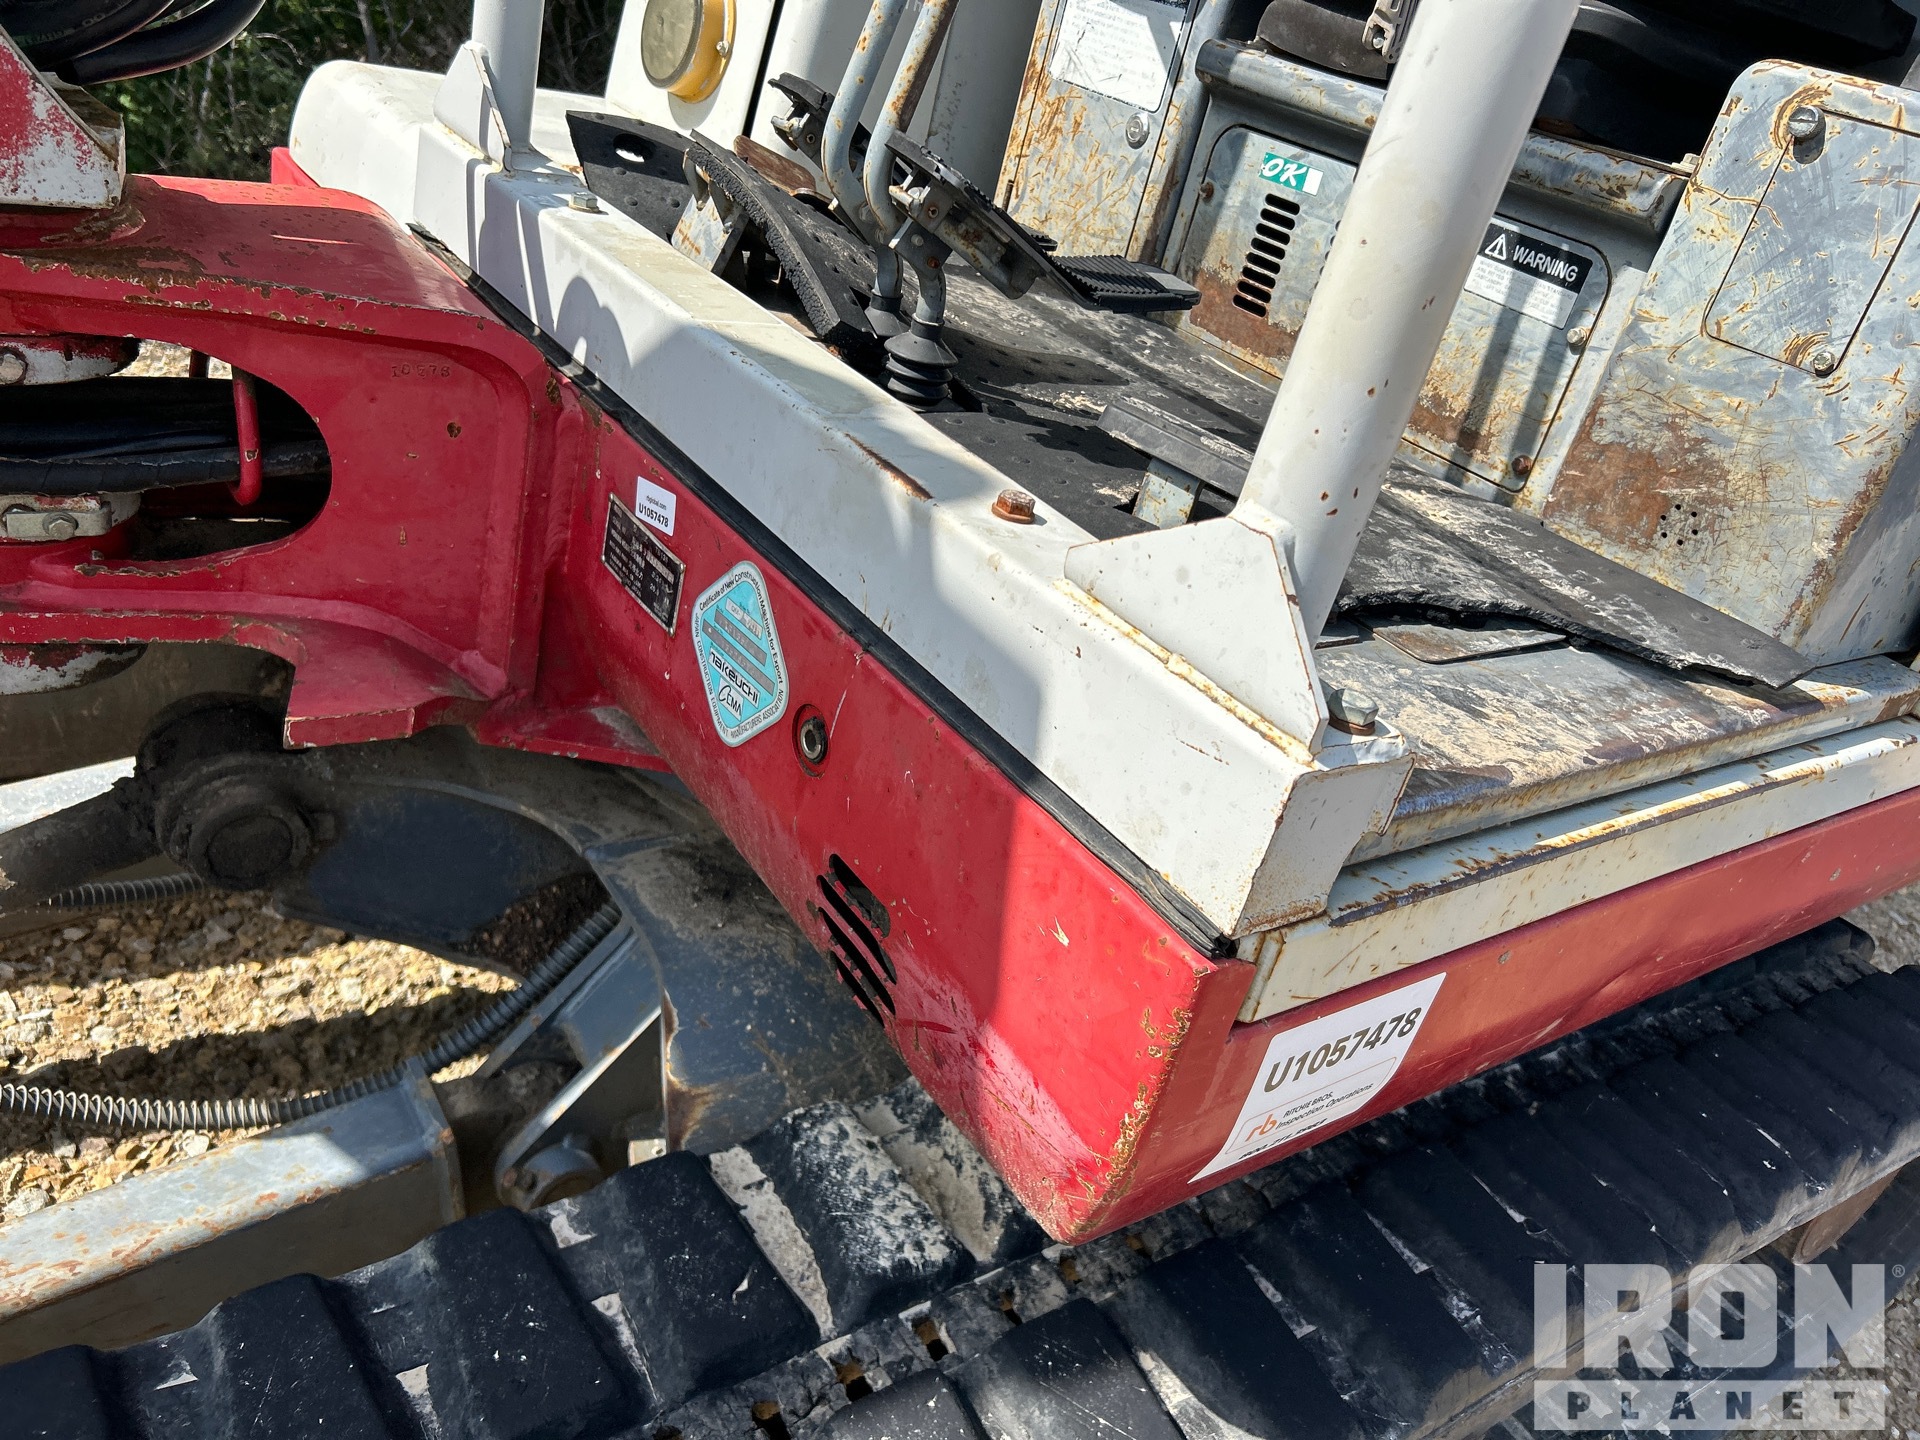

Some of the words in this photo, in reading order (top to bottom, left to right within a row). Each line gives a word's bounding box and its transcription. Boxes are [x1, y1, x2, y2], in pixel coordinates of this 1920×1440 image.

[1261, 158, 1308, 187] OK
[1512, 244, 1579, 282] WARNING
[638, 502, 669, 528] U1057478
[699, 589, 721, 611] Certificate
[724, 578, 735, 592] New
[734, 571, 762, 600] Construction
[760, 599, 772, 638] Machine
[772, 652, 784, 684] Export
[696, 640, 713, 695] CONSTRUCTION
[762, 689, 784, 721] ASSOCIATION
[1264, 1007, 1422, 1093] U1057478
[1275, 1104, 1325, 1130] Inspection
[1325, 1083, 1374, 1108] Operations
[1282, 1100, 1313, 1118] RITCHIE
[1245, 1113, 1278, 1143] rb
